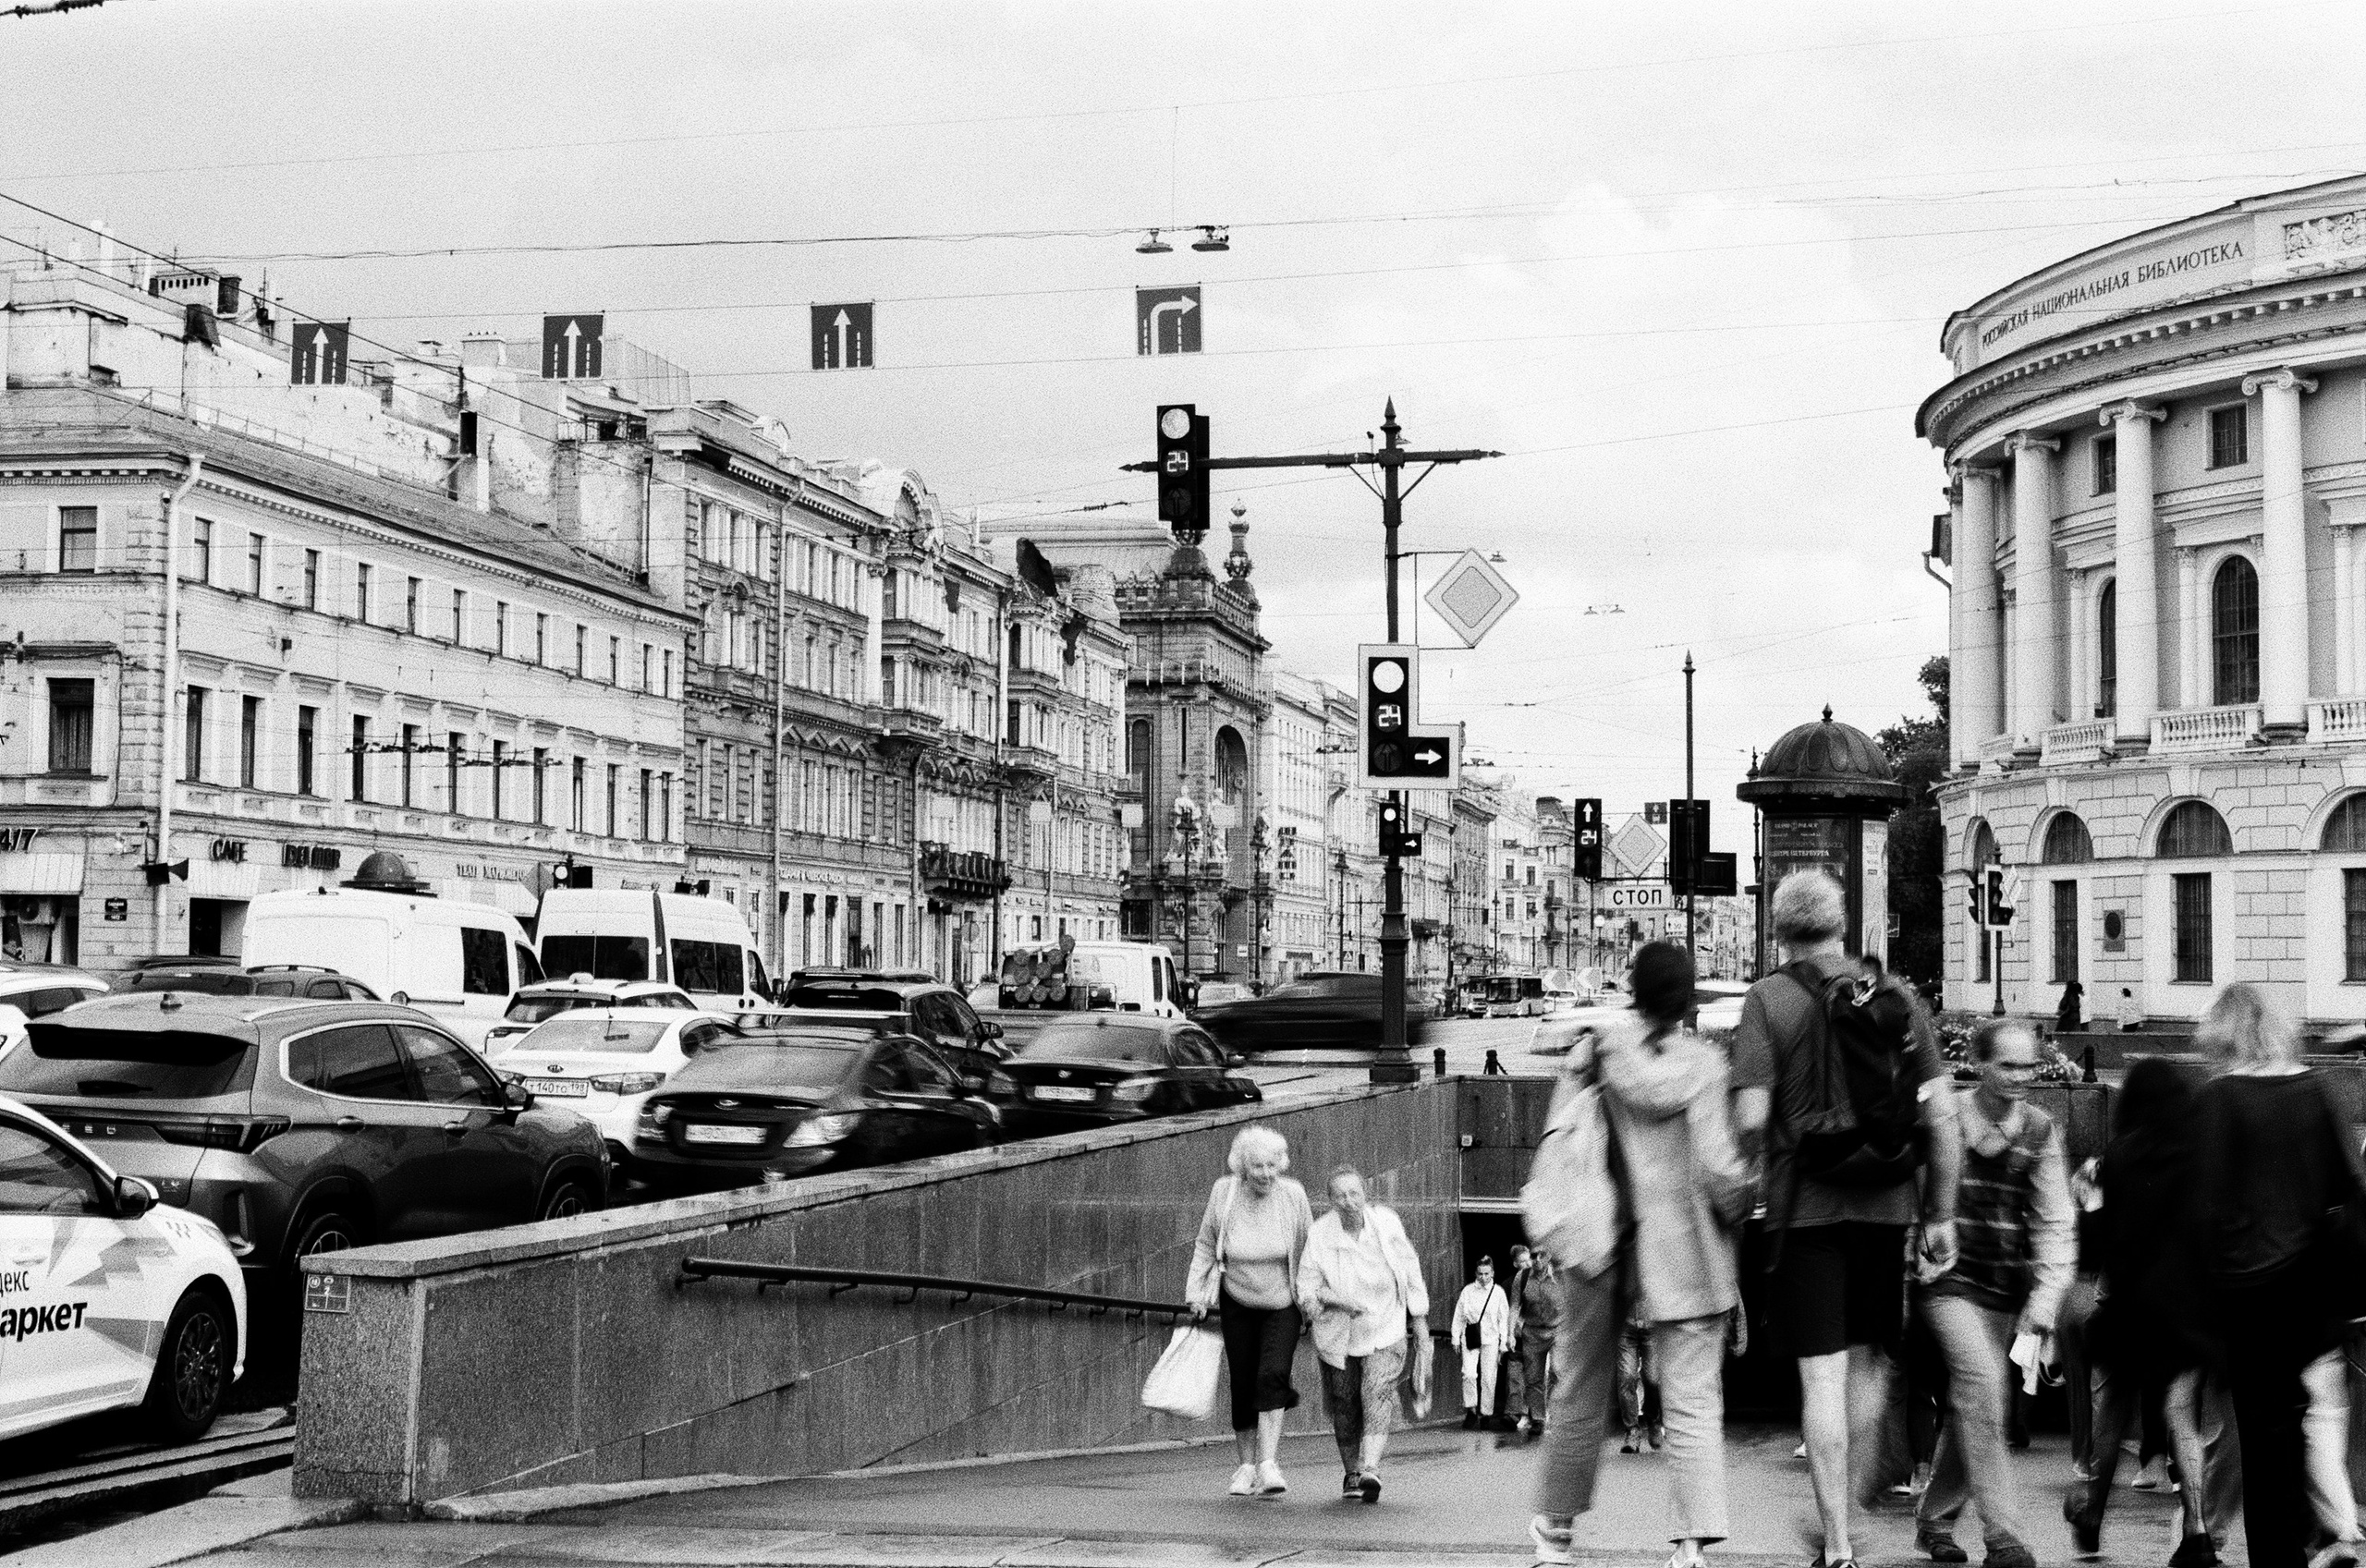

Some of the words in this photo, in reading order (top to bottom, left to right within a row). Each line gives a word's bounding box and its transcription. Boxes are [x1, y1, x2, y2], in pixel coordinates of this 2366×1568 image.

[1982, 309, 2028, 350] РОССИЙСКАЯ
[2033, 271, 2130, 322] НАЦИОНАЛЬНАЯ
[2138, 241, 2243, 283] БИБЛИОТЕКА
[1167, 451, 1189, 472] 24
[1378, 704, 1401, 727] 24
[1580, 830, 1597, 845] 24
[1613, 889, 1662, 905] СТОП
